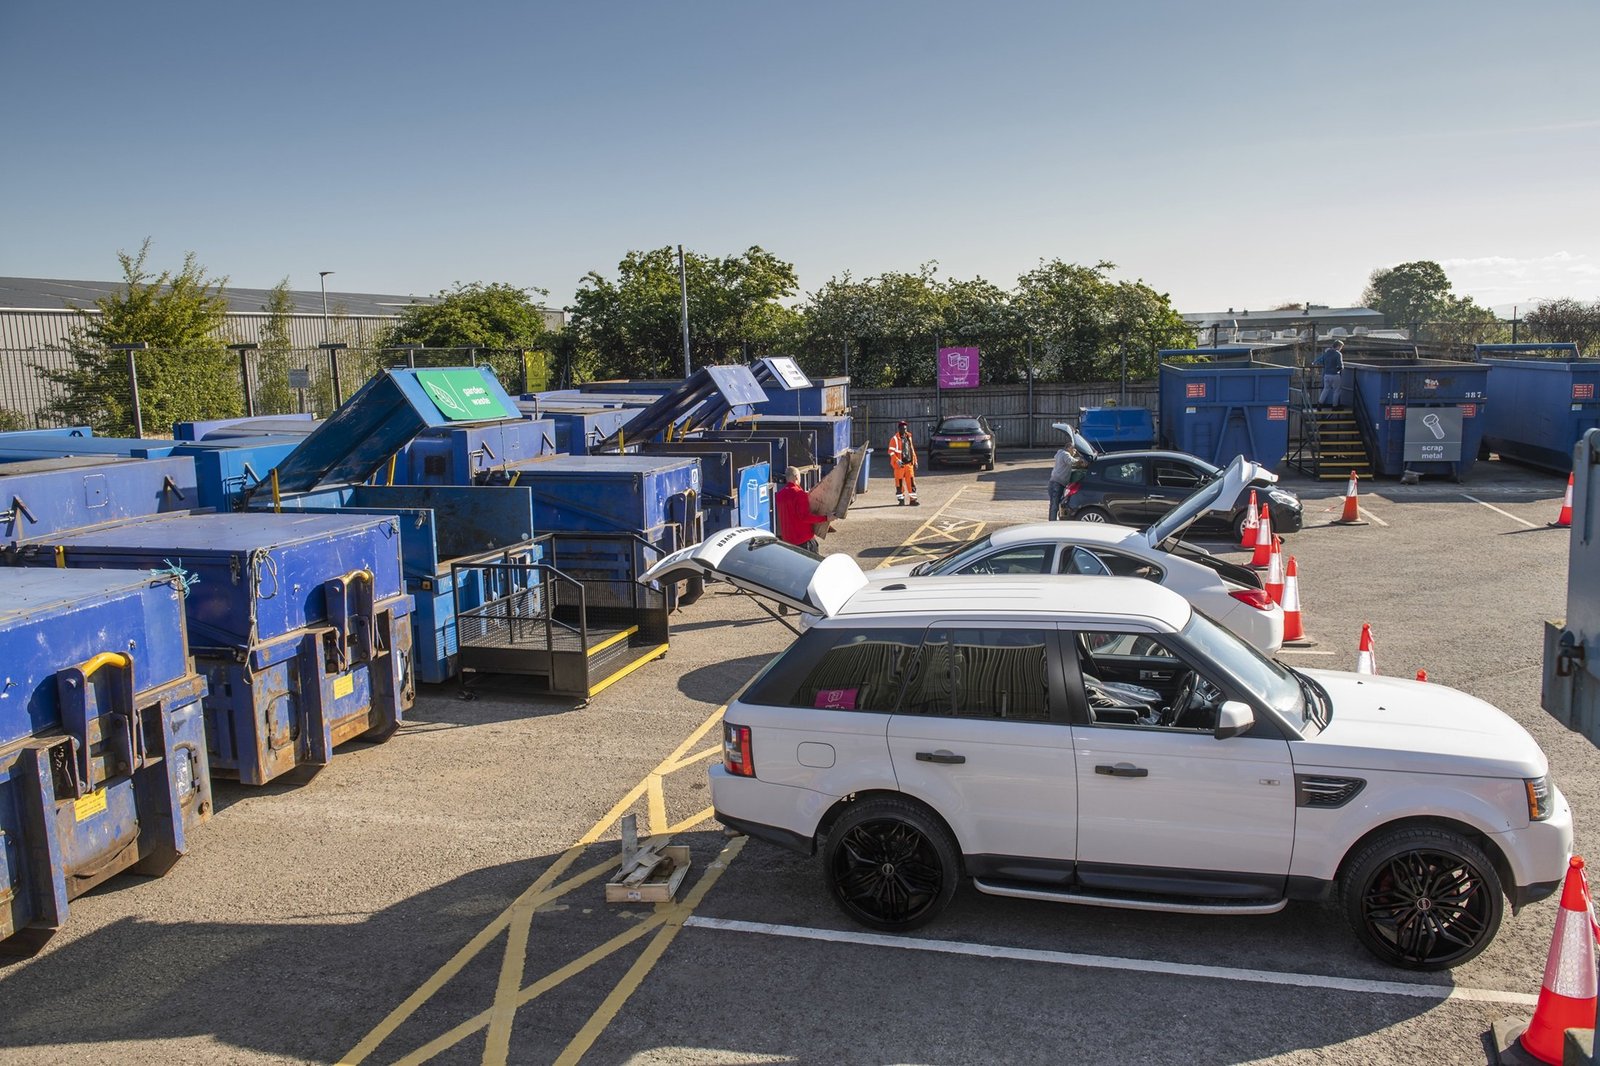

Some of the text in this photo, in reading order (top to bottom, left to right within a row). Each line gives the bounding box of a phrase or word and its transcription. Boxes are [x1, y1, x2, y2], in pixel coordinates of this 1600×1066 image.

[462, 385, 485, 397] garden
[1464, 391, 1482, 399] 387
[471, 397, 491, 406] waste
[716, 532, 737, 548] ROVER
